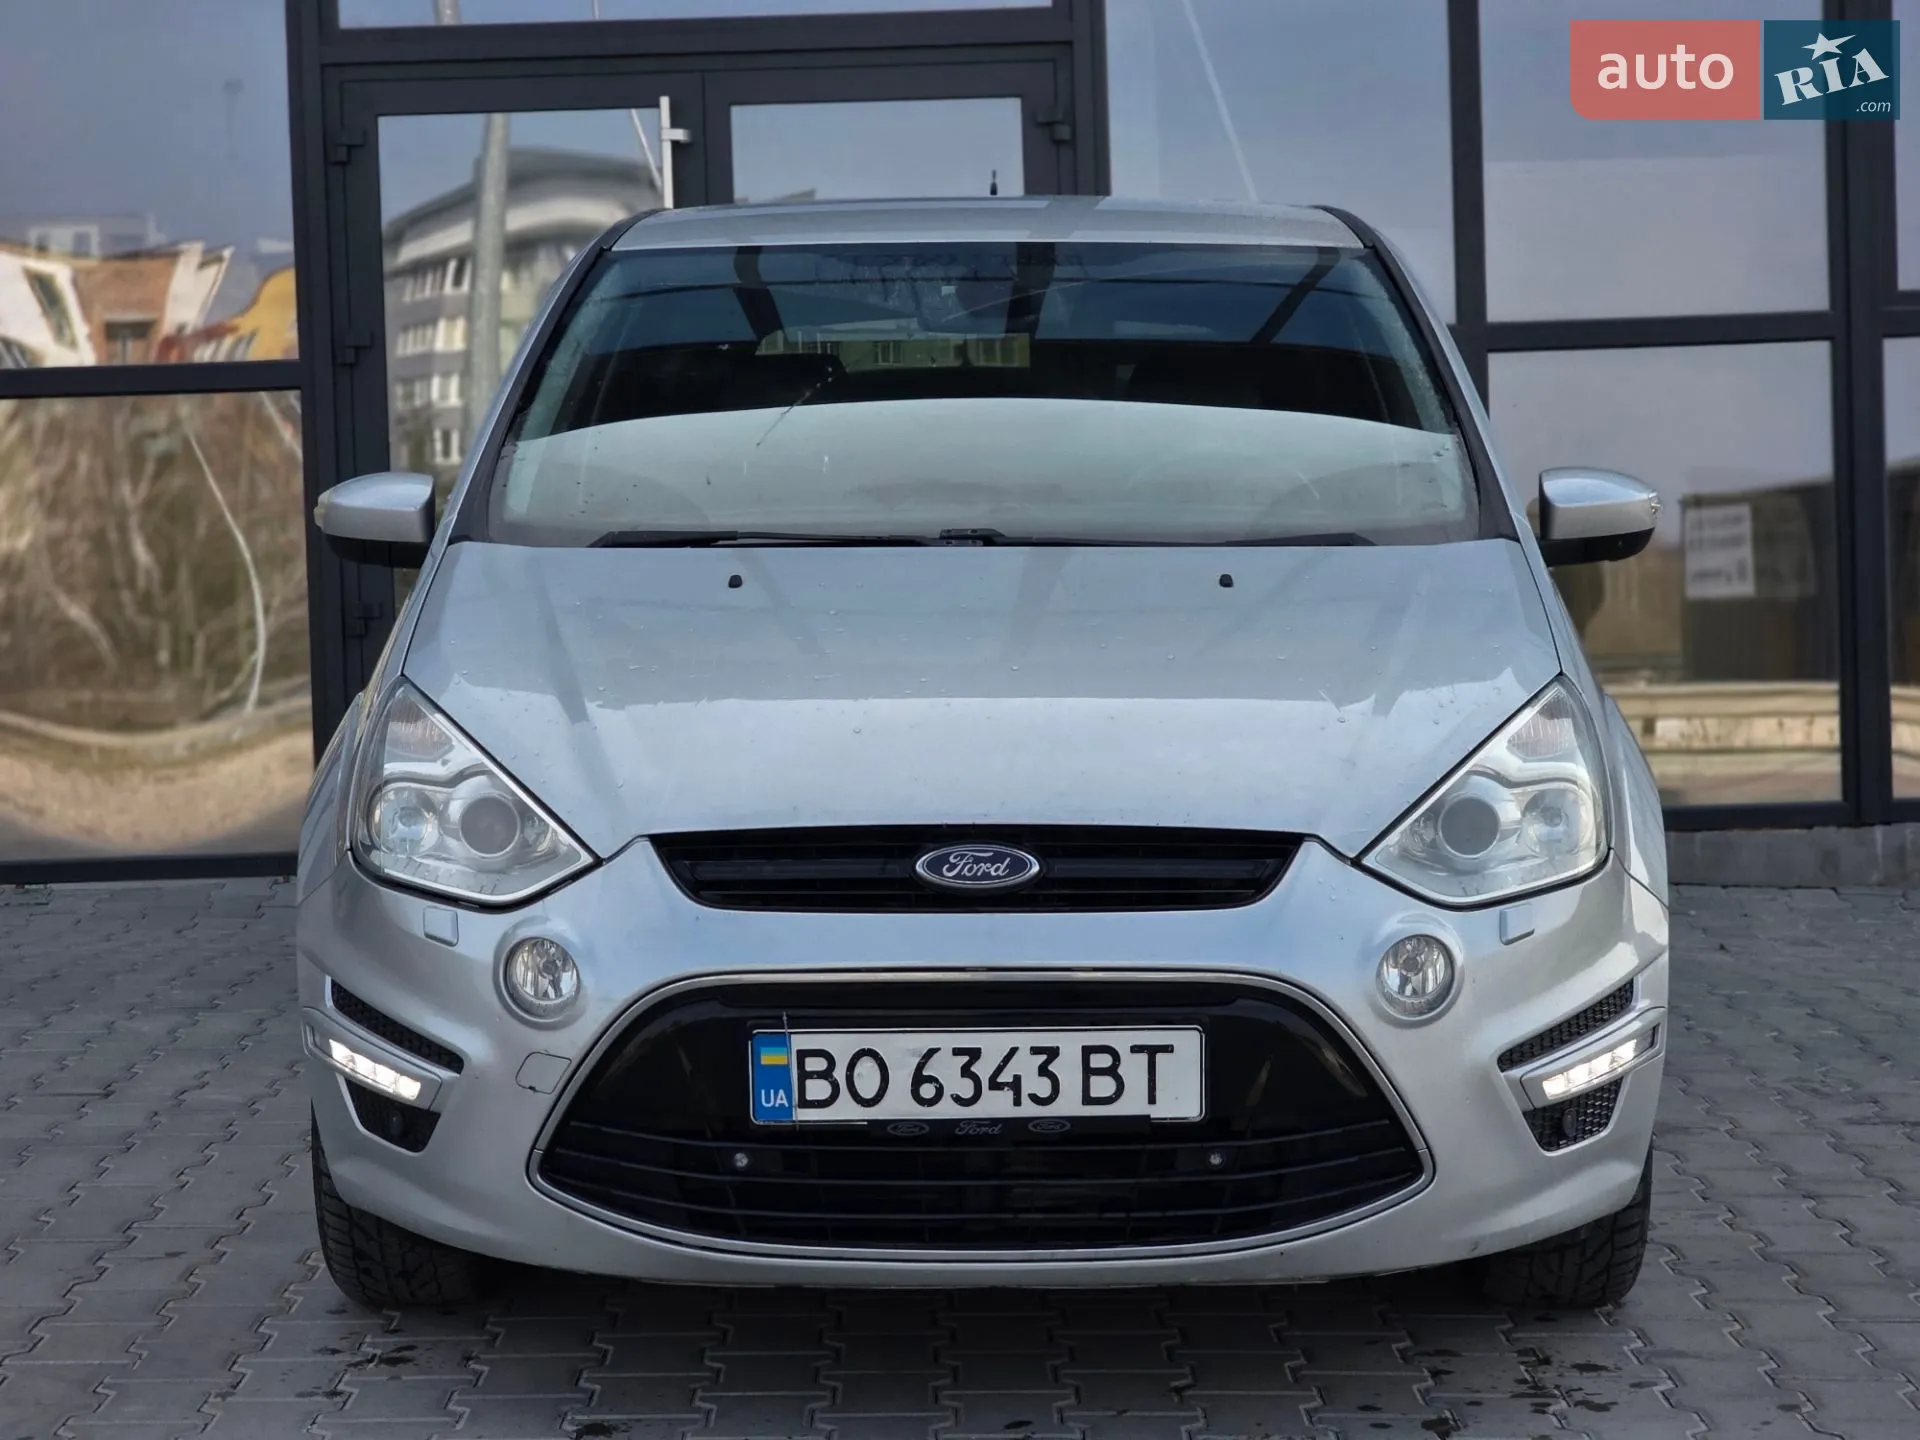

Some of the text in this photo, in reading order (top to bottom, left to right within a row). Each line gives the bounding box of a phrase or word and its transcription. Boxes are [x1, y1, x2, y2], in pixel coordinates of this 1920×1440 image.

[942, 851, 1011, 877] Ford
[796, 1044, 1175, 1109] BO 6343 BT
[760, 1088, 790, 1108] UA
[954, 1120, 1004, 1136] Ford
